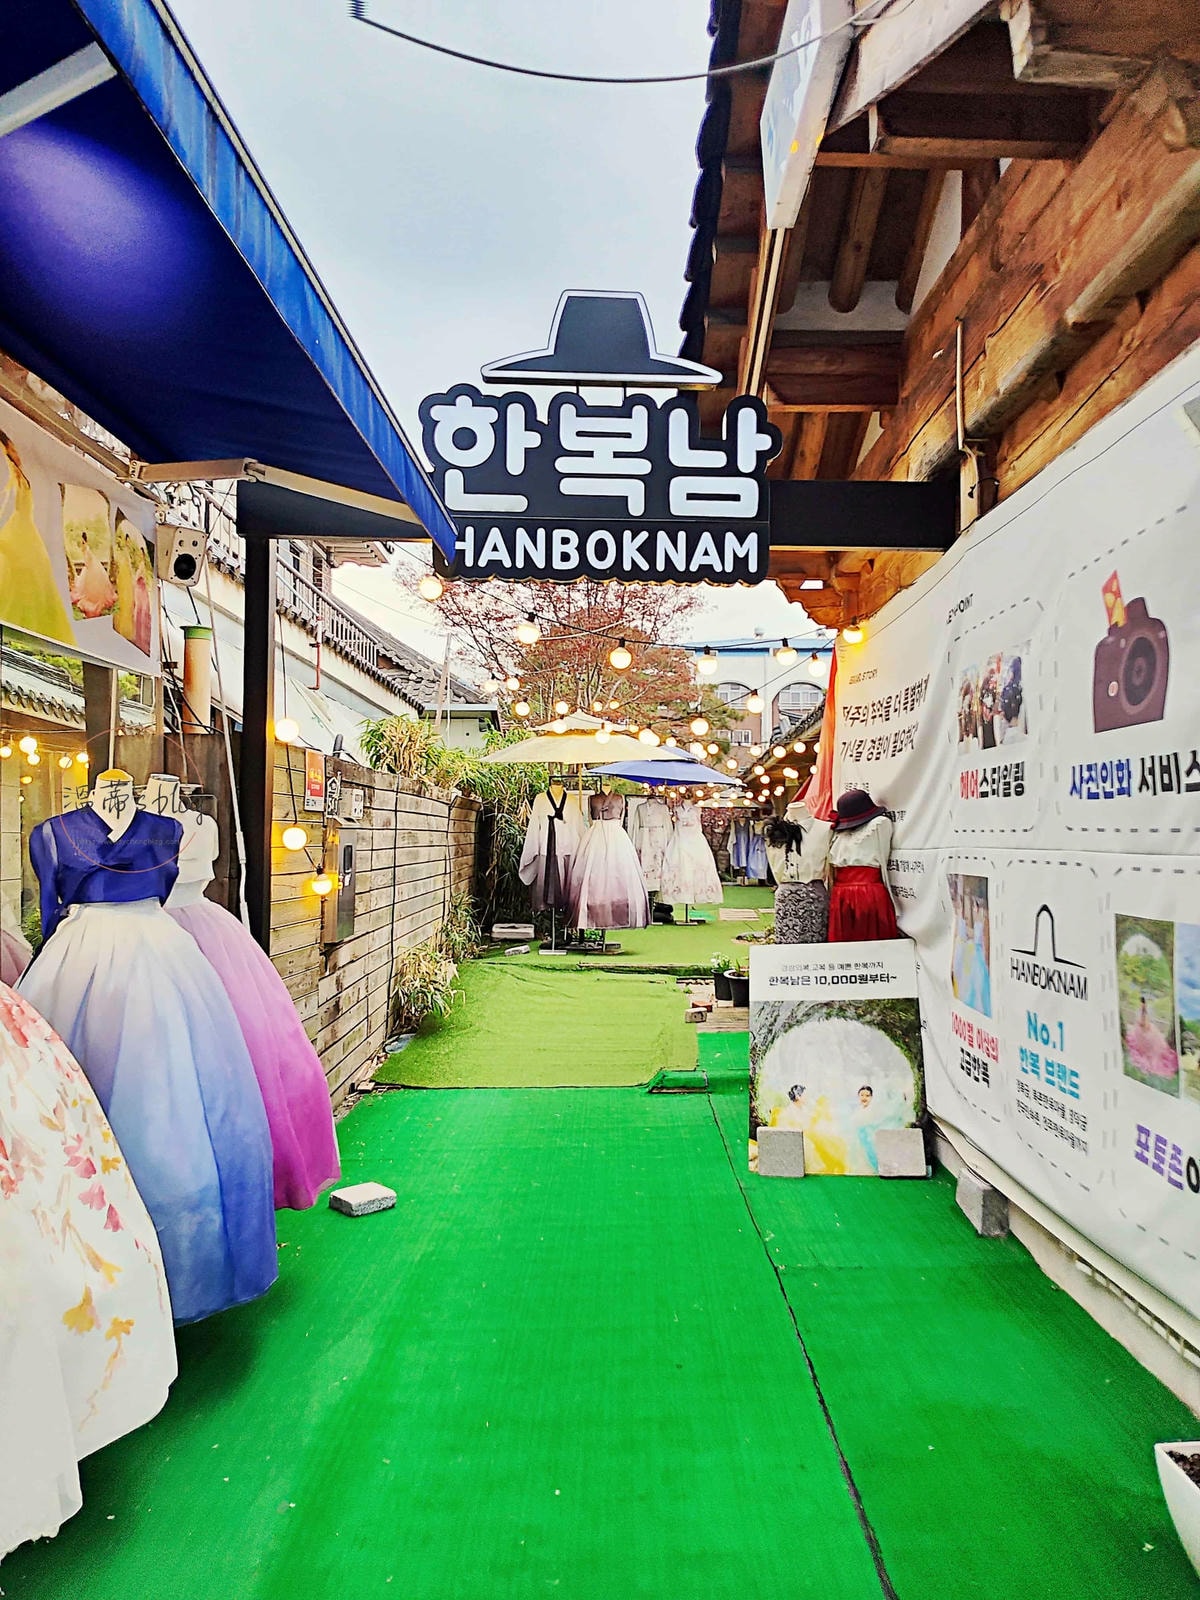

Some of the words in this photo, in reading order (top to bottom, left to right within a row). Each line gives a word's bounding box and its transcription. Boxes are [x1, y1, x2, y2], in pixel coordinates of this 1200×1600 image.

[430, 395, 772, 517] 한복남
[455, 526, 758, 573] HANBOKNAM
[959, 761, 1025, 799] 헤어스타일링
[1069, 758, 1132, 800] 사진인화
[1138, 750, 1200, 796] 서비스
[768, 975, 811, 986] 한복남은
[814, 973, 897, 986] 10,000원부터~
[1010, 957, 1088, 1001] HANBOKNAM
[1026, 1009, 1065, 1051] No.1
[1019, 1045, 1040, 1080] 한복
[1044, 1057, 1080, 1100] 브랜드
